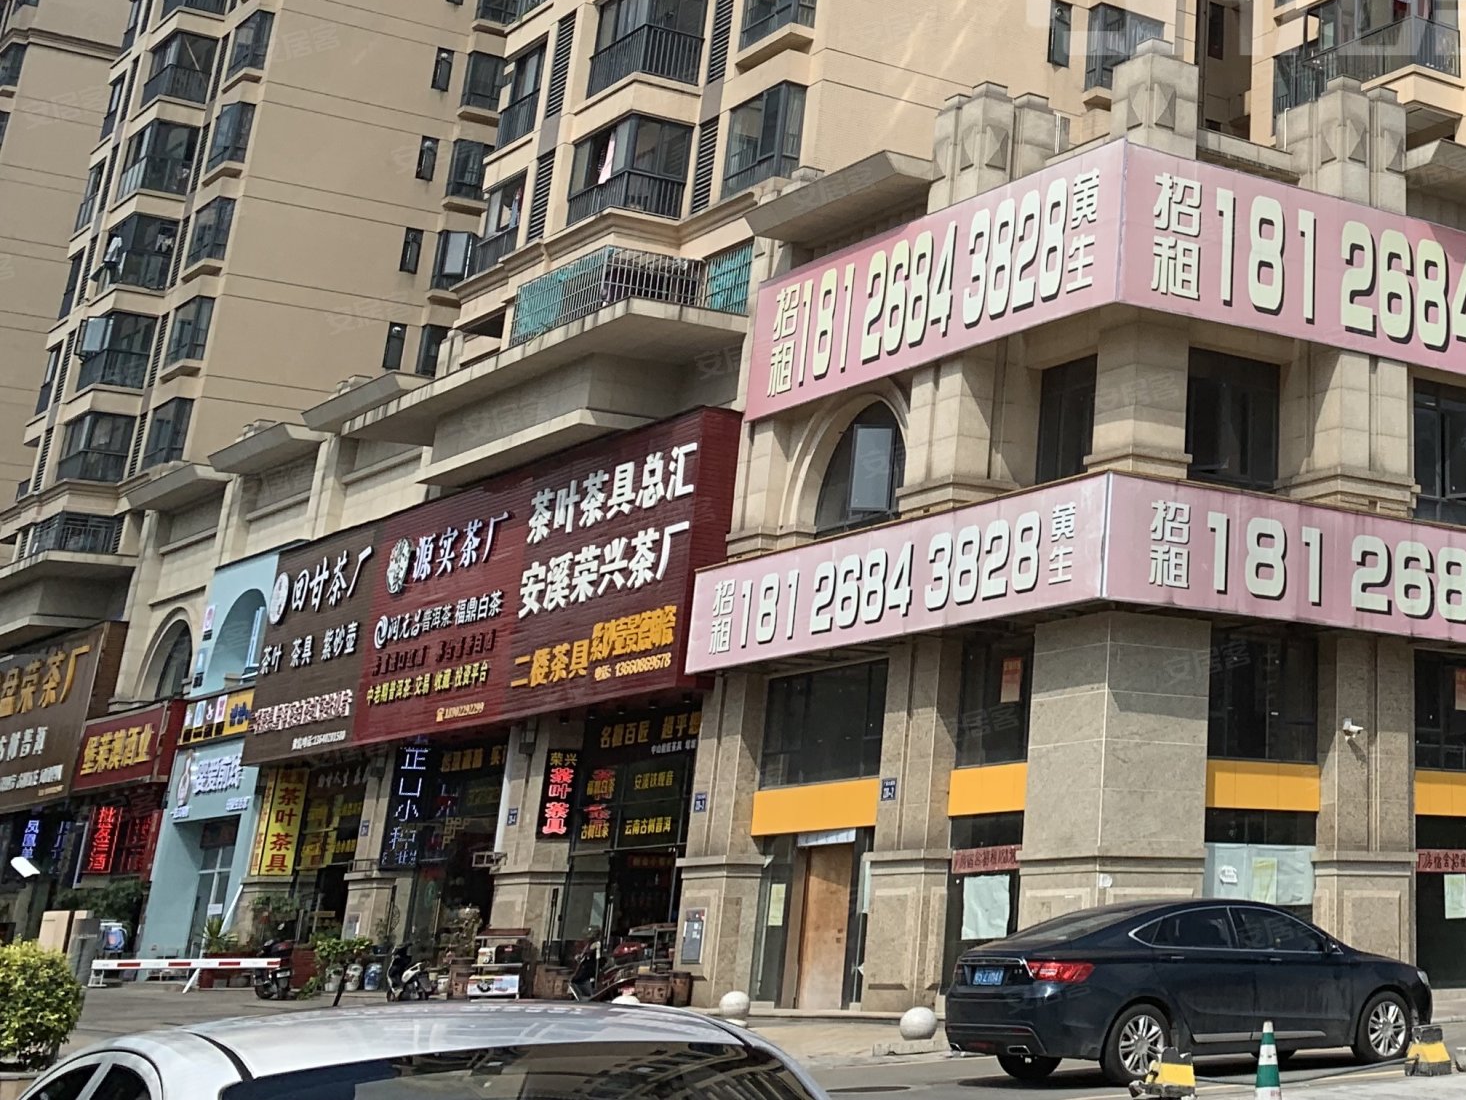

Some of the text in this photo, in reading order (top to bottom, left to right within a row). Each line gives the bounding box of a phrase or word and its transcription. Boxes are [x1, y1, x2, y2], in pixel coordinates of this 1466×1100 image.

[767, 167, 1100, 397] 招租 181 2684 3828 黄生
[1151, 172, 1202, 301] 招租
[1215, 187, 1318, 324] 181
[526, 442, 698, 544] 茶叶茶具总汇
[291, 546, 373, 612] 回甘茶厂
[412, 511, 510, 583] 源实茶厂
[518, 521, 690, 619] 安溪荣兴茶厂
[707, 501, 1077, 656] 招租 181 2684 3828 黄生
[1149, 498, 1192, 591] 招租
[1206, 510, 1324, 607] 181
[260, 645, 284, 675] 茶叶
[290, 634, 314, 668] 茶具
[265, 832, 294, 873] 茶具
[274, 786, 301, 827] 茶叶
